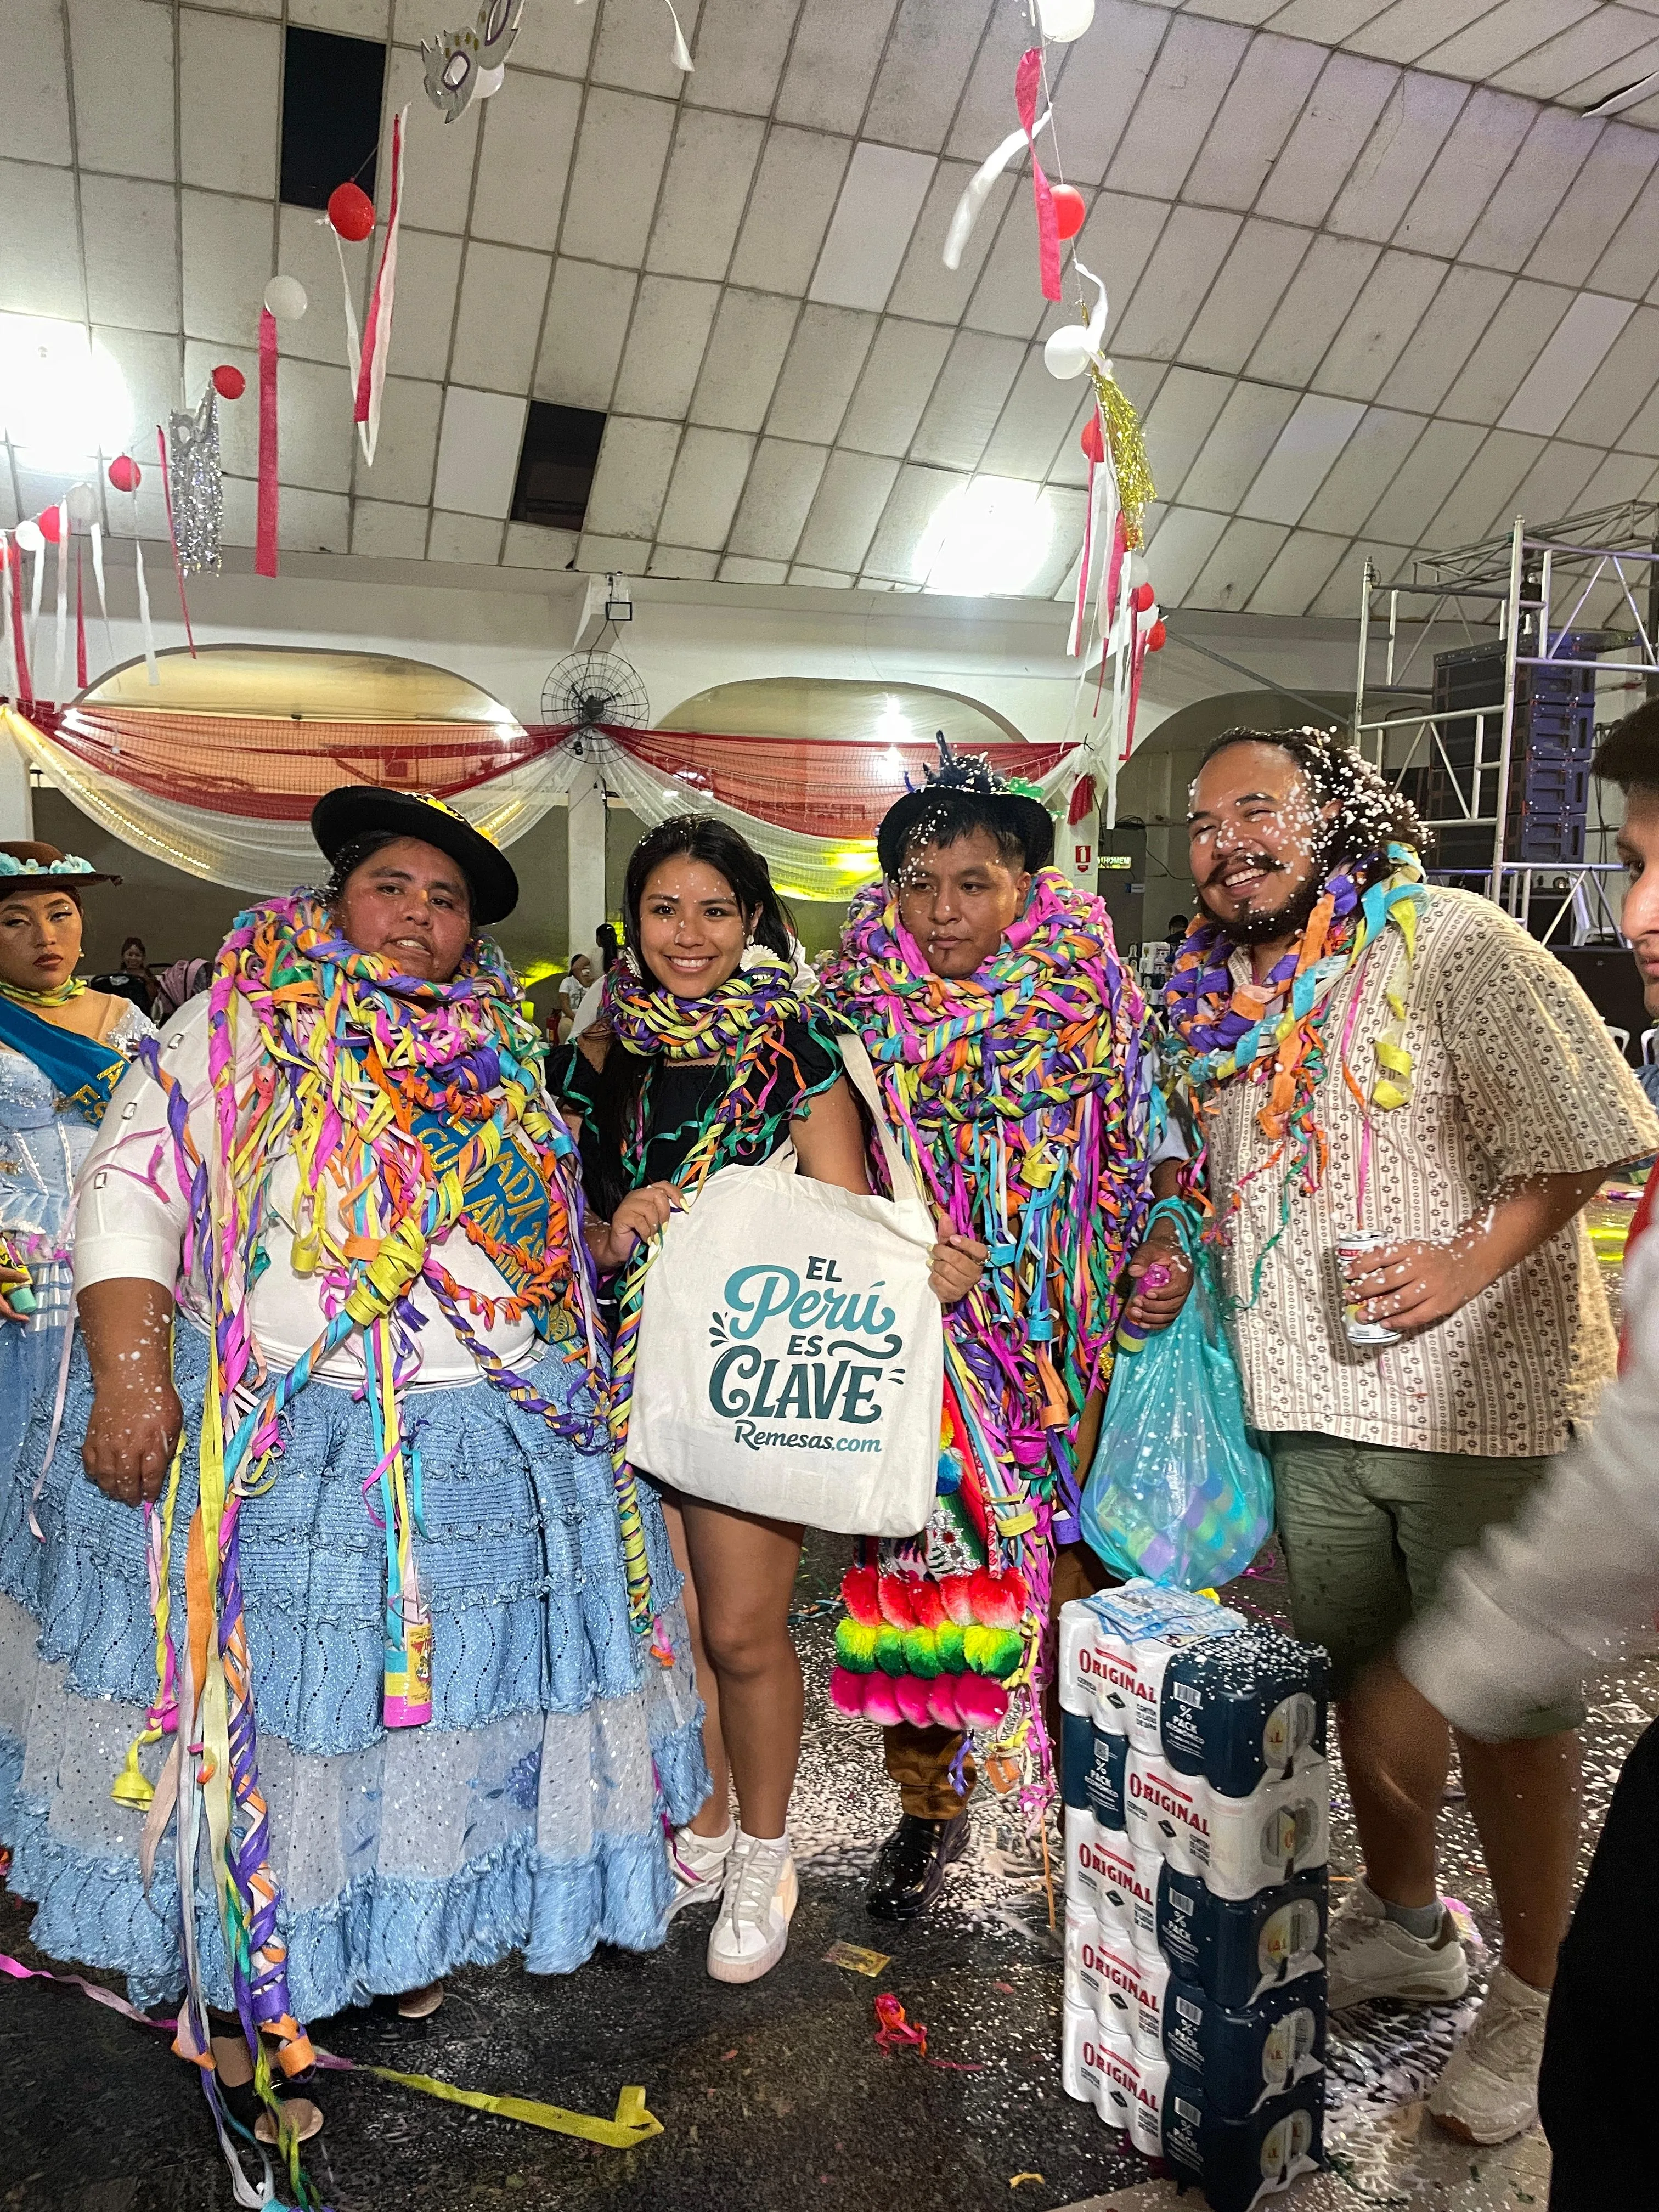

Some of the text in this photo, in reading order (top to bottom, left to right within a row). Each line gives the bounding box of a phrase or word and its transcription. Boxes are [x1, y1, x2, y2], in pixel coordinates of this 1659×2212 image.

[805, 1256, 842, 1283] EL
[724, 1264, 896, 1340] Perú
[787, 1335, 823, 1357] ES
[709, 1345, 883, 1424] CLAVE
[734, 1419, 882, 1453] Remesas.com
